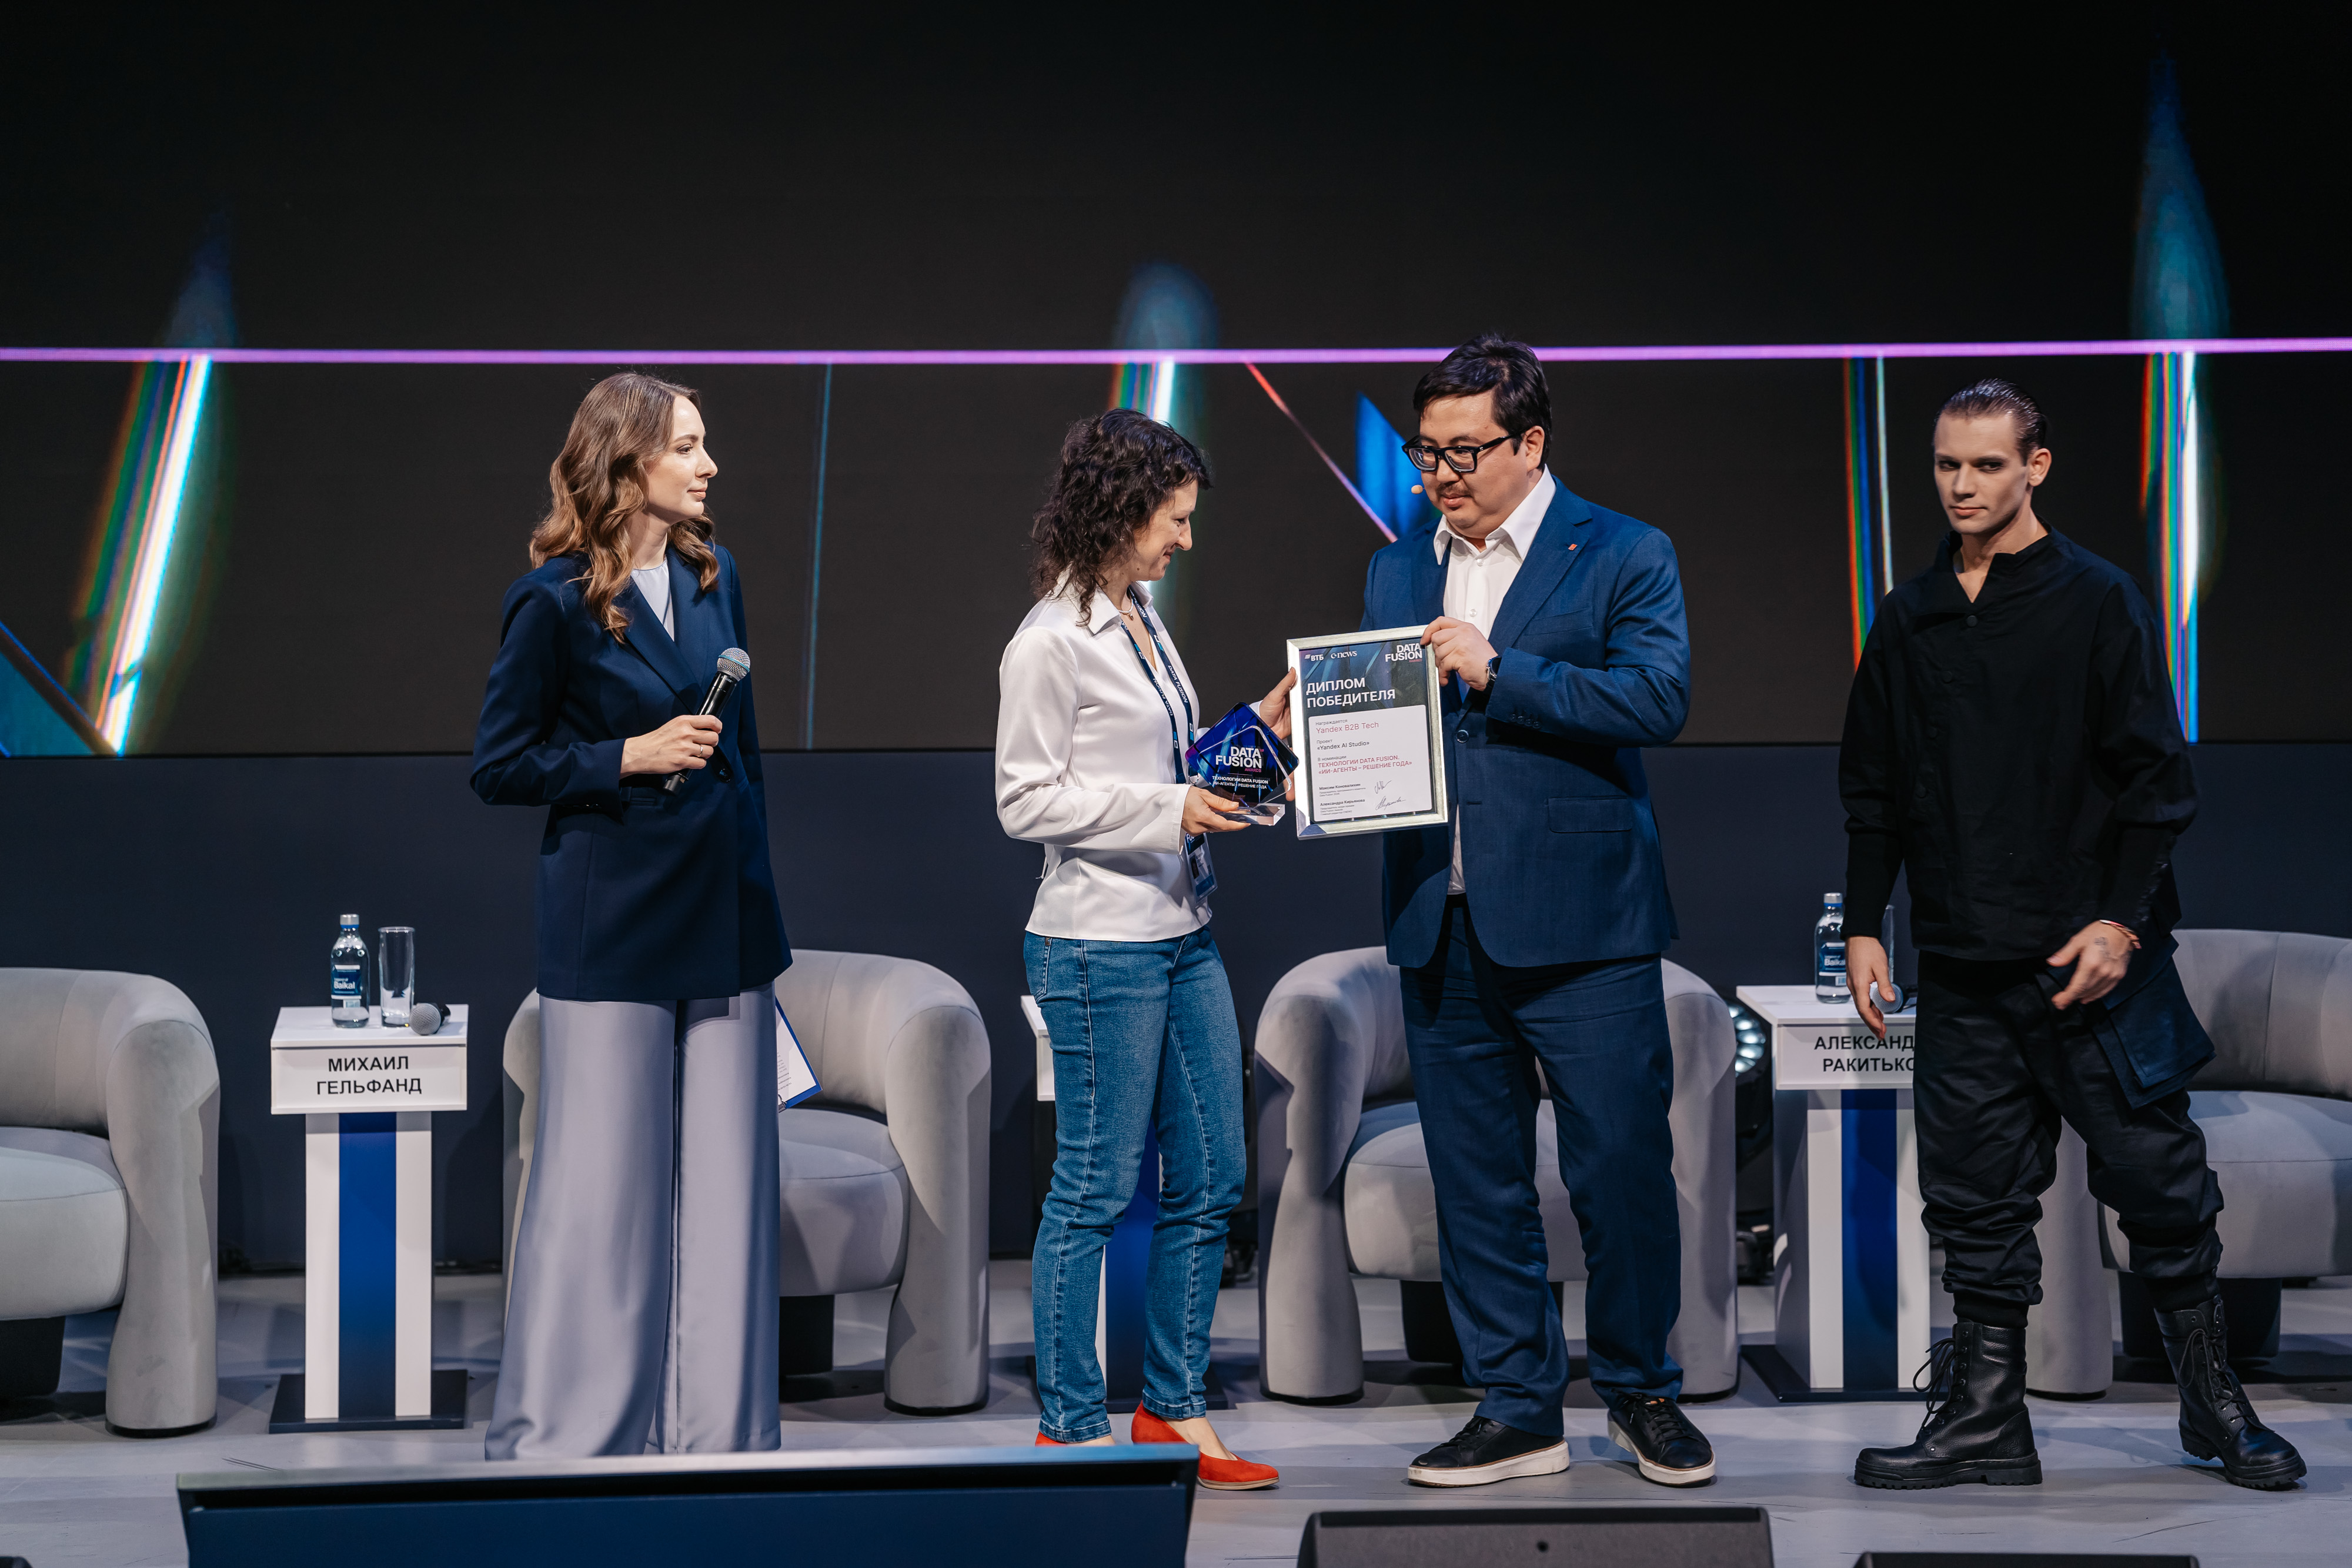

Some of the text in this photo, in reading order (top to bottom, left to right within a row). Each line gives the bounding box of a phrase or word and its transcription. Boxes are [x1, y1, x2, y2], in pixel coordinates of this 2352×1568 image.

[1396, 643, 1422, 653] DATA
[1385, 650, 1422, 662] FUSION
[1168, 665, 1188, 703] DATA FUSION
[1305, 677, 1365, 696] ДИПЛОМ
[1152, 678, 1173, 716] DATA FUSION
[1307, 689, 1395, 708] ПОБЕДИТЕЛЯ
[1316, 726, 1342, 734] Yandex
[1231, 746, 1261, 758] DATA
[1215, 755, 1262, 768] FUSION
[1318, 759, 1358, 768] ТЕХНОЛОГИИ
[1318, 766, 1357, 774] «ИИ-АГЕНТЫ
[1363, 762, 1391, 770] РЕШЕНИЕ
[333, 981, 356, 989] Baikal
[328, 1056, 409, 1072] МИХАИЛ
[316, 1078, 422, 1095] ГЕЛЬФАНД
